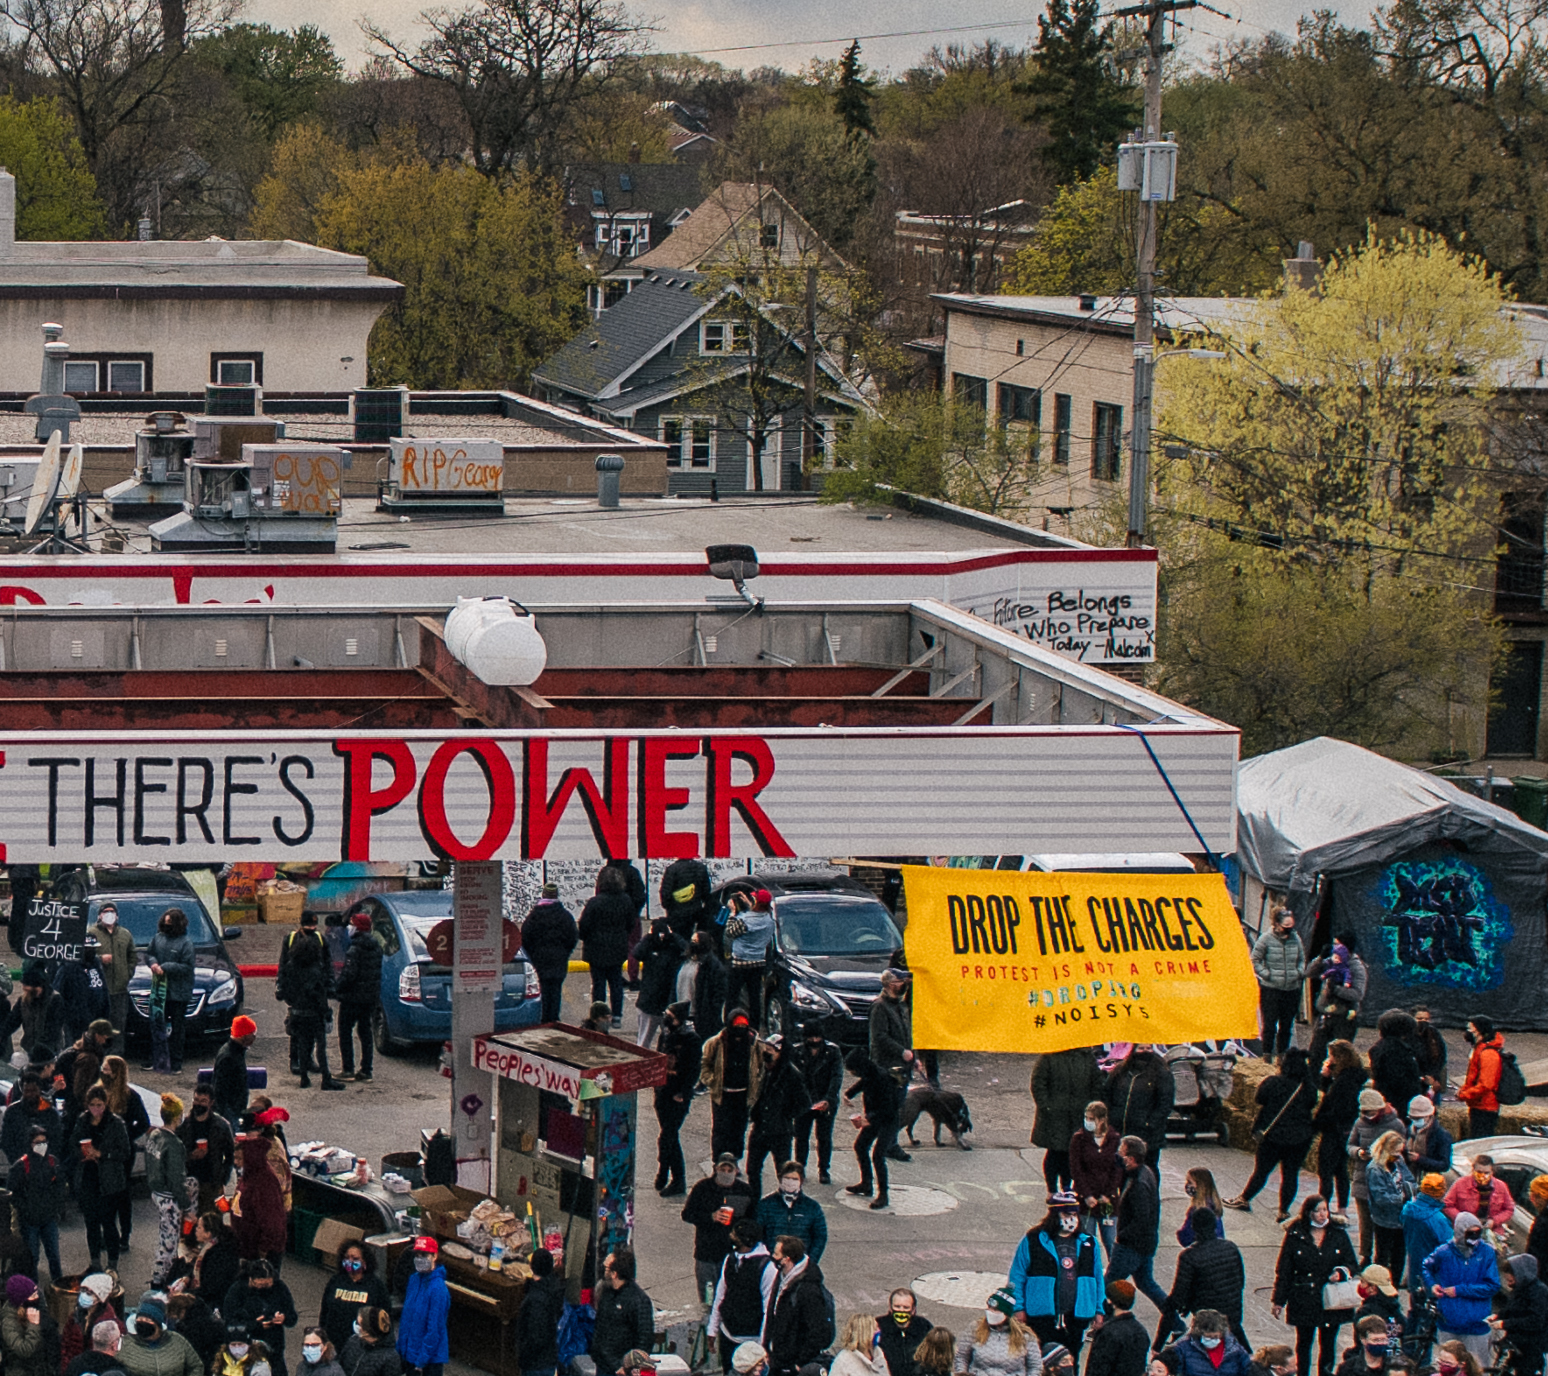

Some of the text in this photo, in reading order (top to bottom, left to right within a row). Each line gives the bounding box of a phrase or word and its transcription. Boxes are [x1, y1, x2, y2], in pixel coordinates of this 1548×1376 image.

[403, 448, 445, 489] RIP
[1048, 590, 1131, 616] Belongs
[1024, 613, 1150, 640] Who Prepare
[1047, 636, 1091, 661] Today
[28, 753, 314, 847] THERE'S
[333, 737, 796, 862] POWER
[460, 866, 494, 875] SERVE
[40, 918, 62, 941] 4
[947, 895, 1214, 955] DROP THE CHARGES
[24, 942, 82, 961] GEORGE
[436, 934, 448, 951] 2
[962, 960, 1211, 982] PROTEST IS NOT A CRIME
